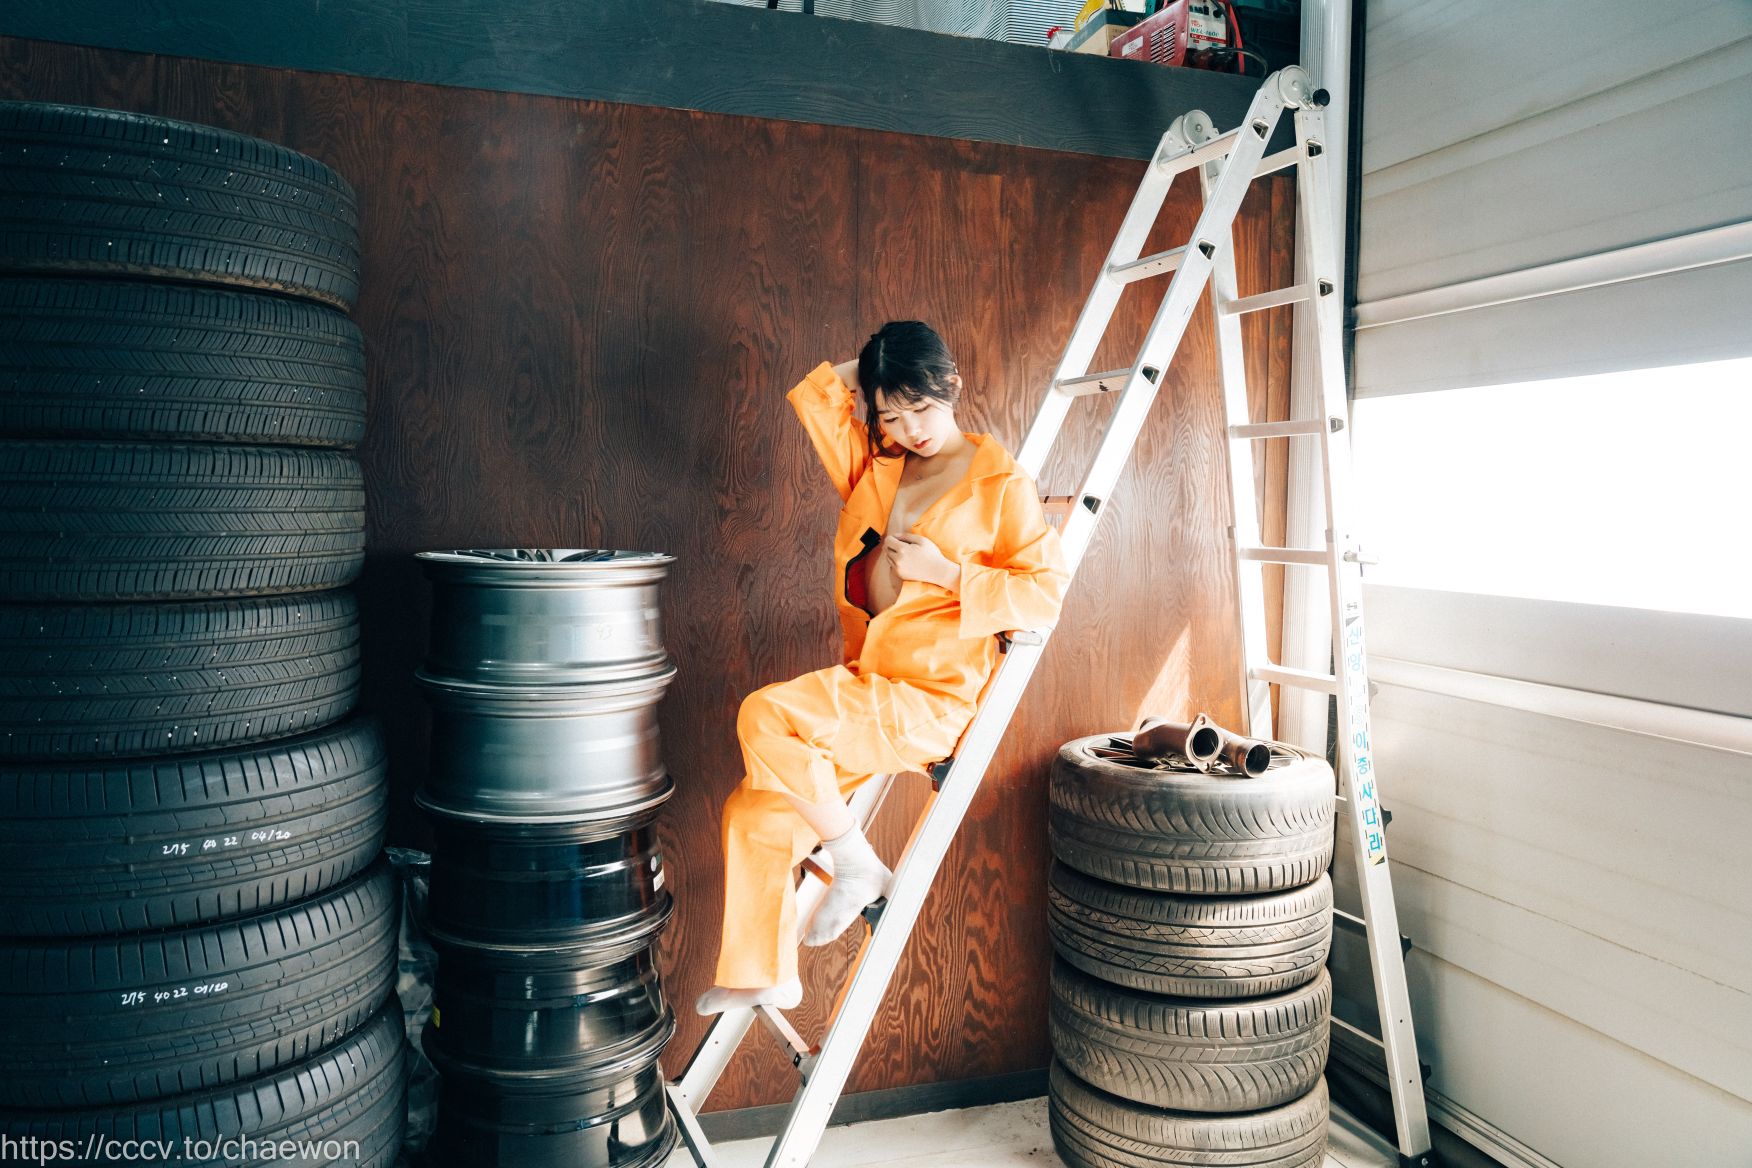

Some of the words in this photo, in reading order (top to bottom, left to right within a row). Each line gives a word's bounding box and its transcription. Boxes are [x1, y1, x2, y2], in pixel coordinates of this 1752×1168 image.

[162, 843, 191, 856] 275
[203, 839, 217, 850] 40
[224, 836, 238, 847] 22
[251, 829, 291, 842] 04/20
[121, 991, 146, 1006] 275
[154, 992, 170, 1003] 40
[173, 987, 189, 998] 22
